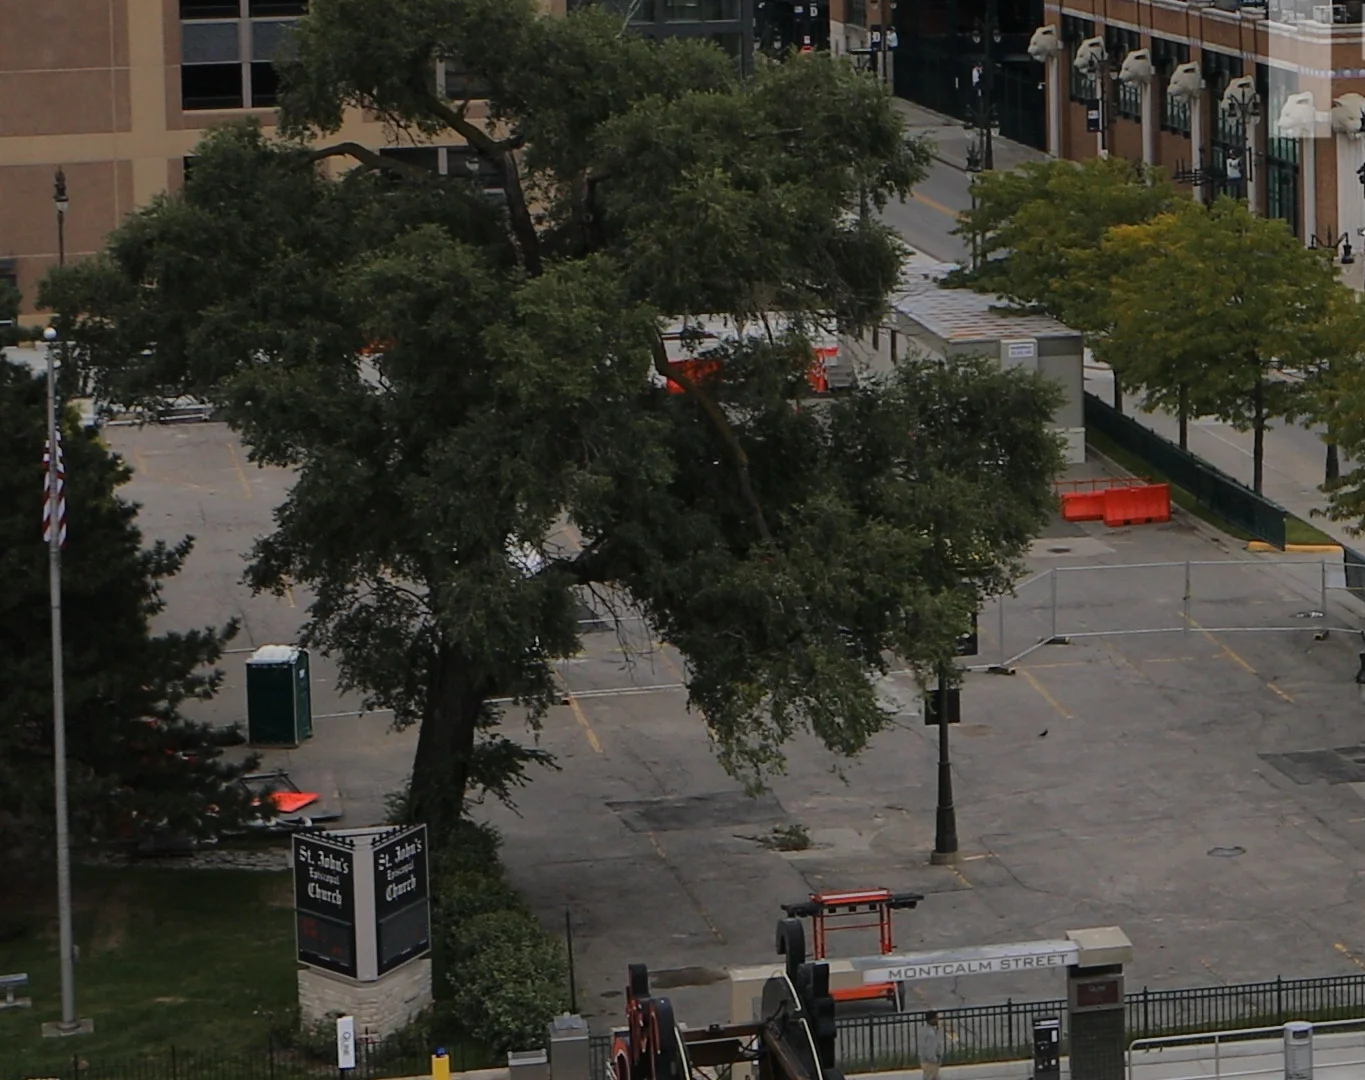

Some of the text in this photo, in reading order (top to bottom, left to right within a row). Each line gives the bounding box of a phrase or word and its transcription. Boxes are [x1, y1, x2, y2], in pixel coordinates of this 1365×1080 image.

[300, 846, 348, 874] St. John's
[379, 838, 422, 870] St. John's
[308, 882, 342, 905] Church
[386, 874, 416, 901] Church
[888, 953, 1068, 980] MONTCALM STREET
